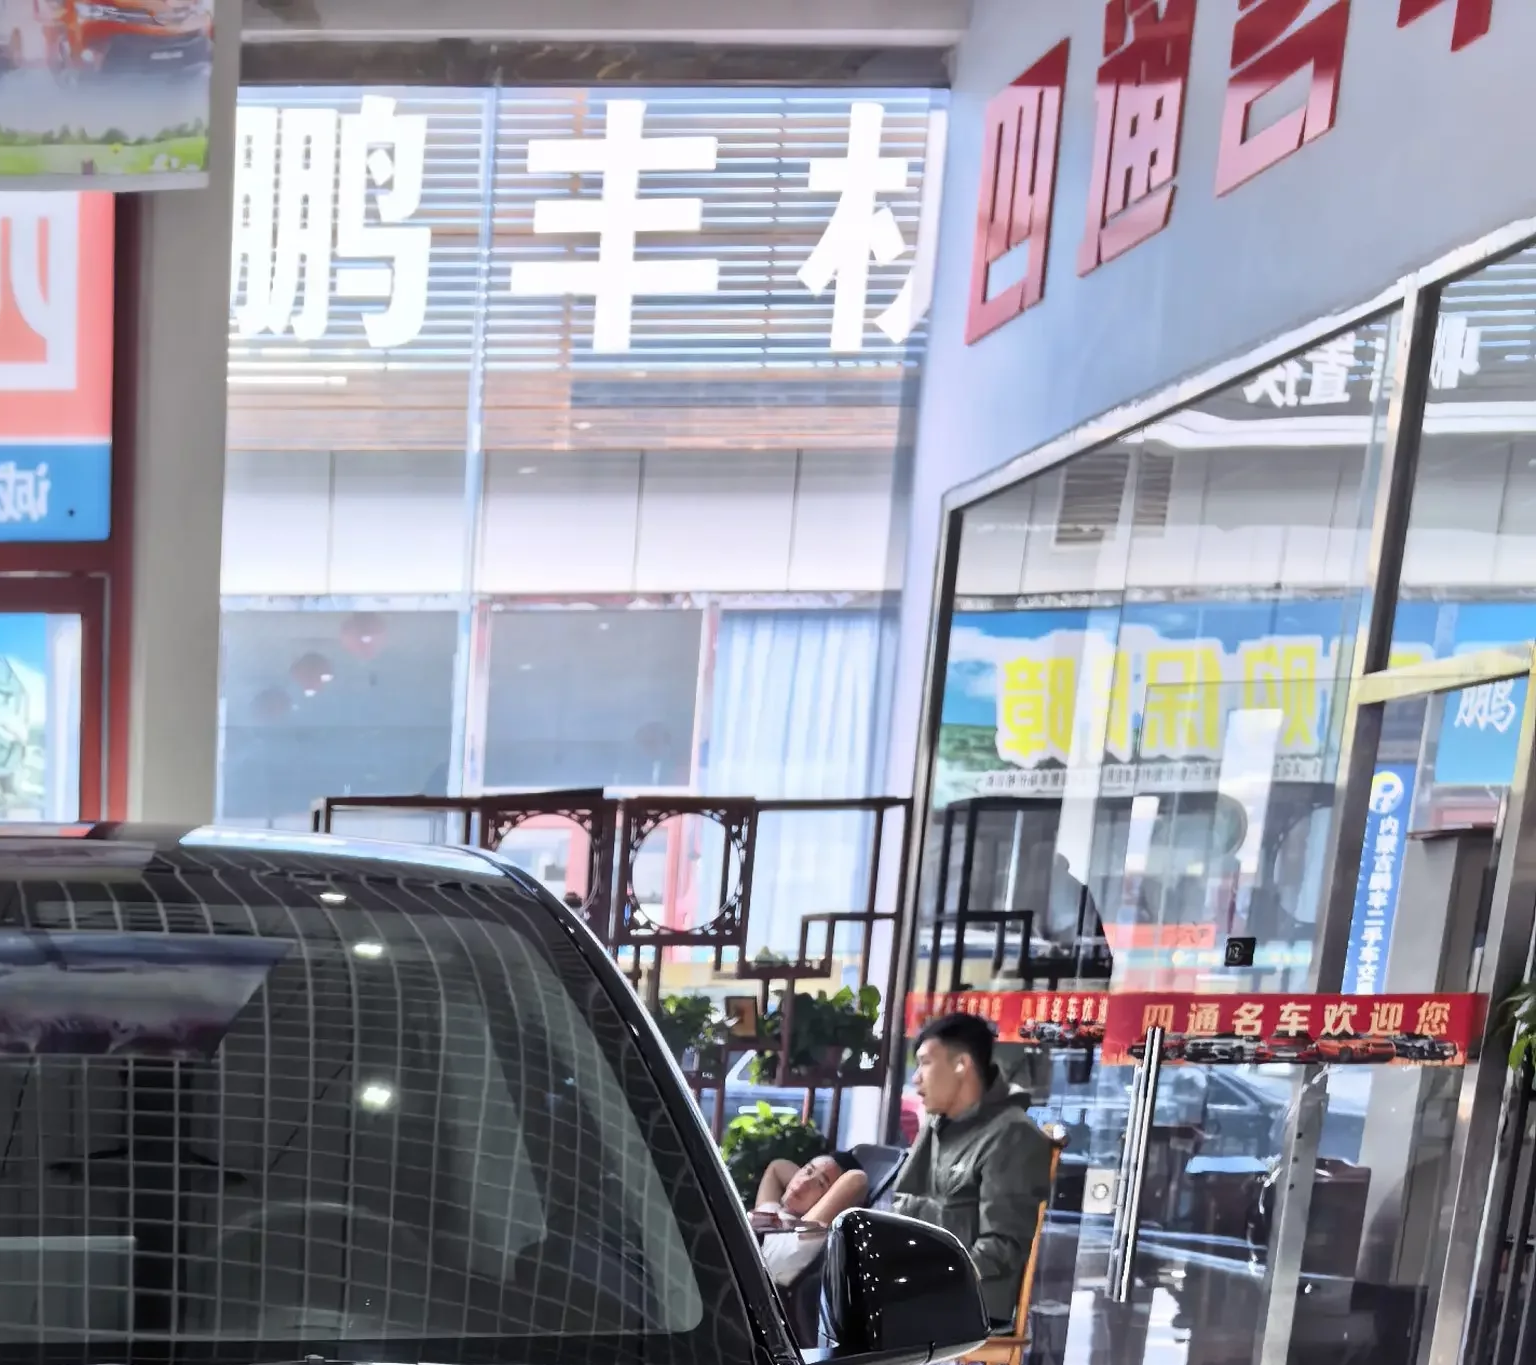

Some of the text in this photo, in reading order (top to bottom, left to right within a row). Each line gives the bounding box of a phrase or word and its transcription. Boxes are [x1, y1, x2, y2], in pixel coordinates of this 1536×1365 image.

[965, 0, 1492, 346] 四通名
[1141, 1001, 1452, 1037] 四通名车欢迎您
